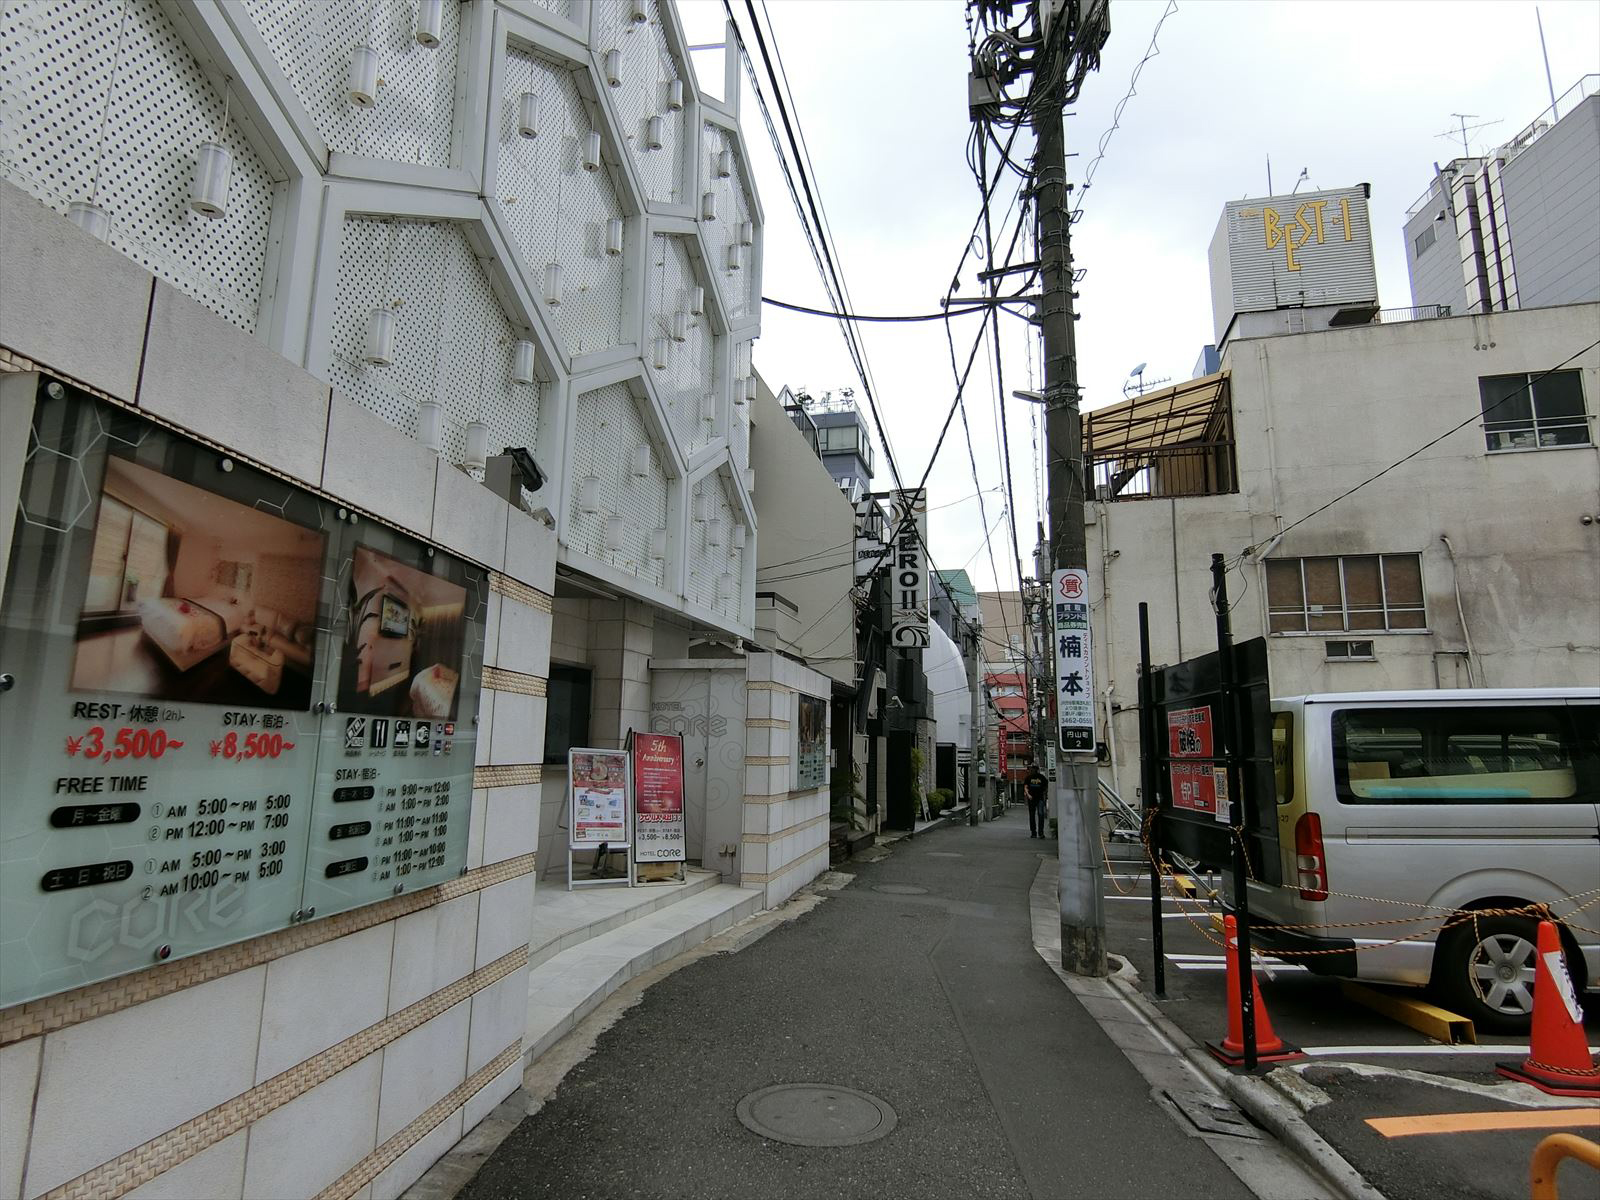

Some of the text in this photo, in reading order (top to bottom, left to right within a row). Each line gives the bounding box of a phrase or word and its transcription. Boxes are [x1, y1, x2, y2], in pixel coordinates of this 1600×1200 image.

[898, 518, 919, 587] ZERO
[652, 701, 686, 712] HOTEL
[650, 739, 667, 753] 5th
[1075, 740, 1082, 748] 2
[55, 776, 148, 794] FREE TIME
[168, 804, 187, 817] AM
[266, 794, 292, 810] 5:00
[166, 827, 184, 840] PM
[265, 812, 289, 829] 7:00
[161, 859, 181, 873] AM
[261, 840, 286, 857] 3:00
[160, 883, 179, 897] AM
[259, 859, 284, 878] 5:00
